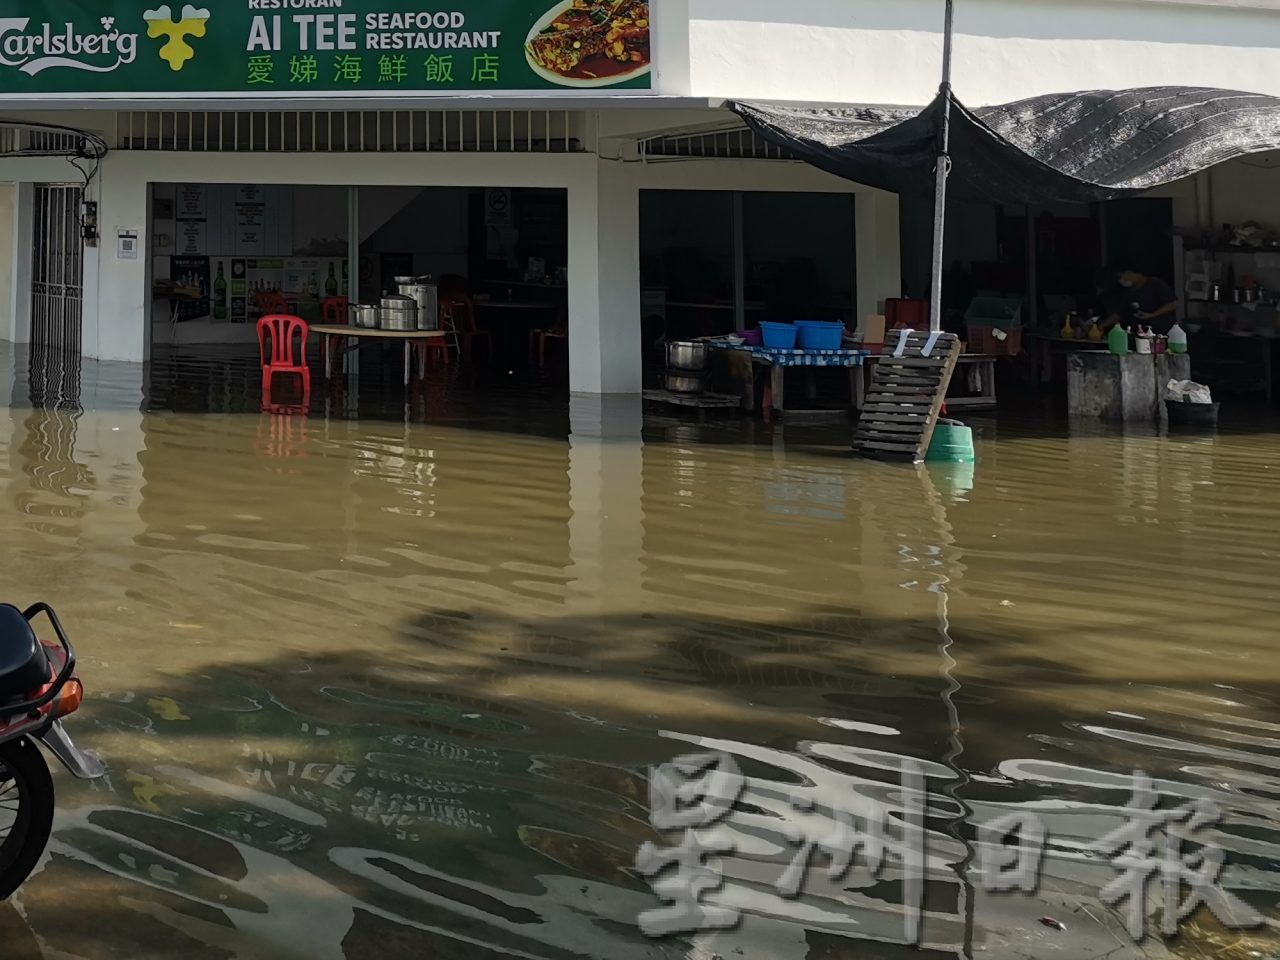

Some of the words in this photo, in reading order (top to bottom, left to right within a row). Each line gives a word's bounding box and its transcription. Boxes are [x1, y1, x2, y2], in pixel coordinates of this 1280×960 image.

[246, 15, 281, 51] AI
[292, 13, 357, 50] TEE
[365, 11, 465, 29] SEAFOOD
[366, 31, 501, 50] RESTAURANT
[247, 53, 500, 84] 愛娣海鮮飯店
